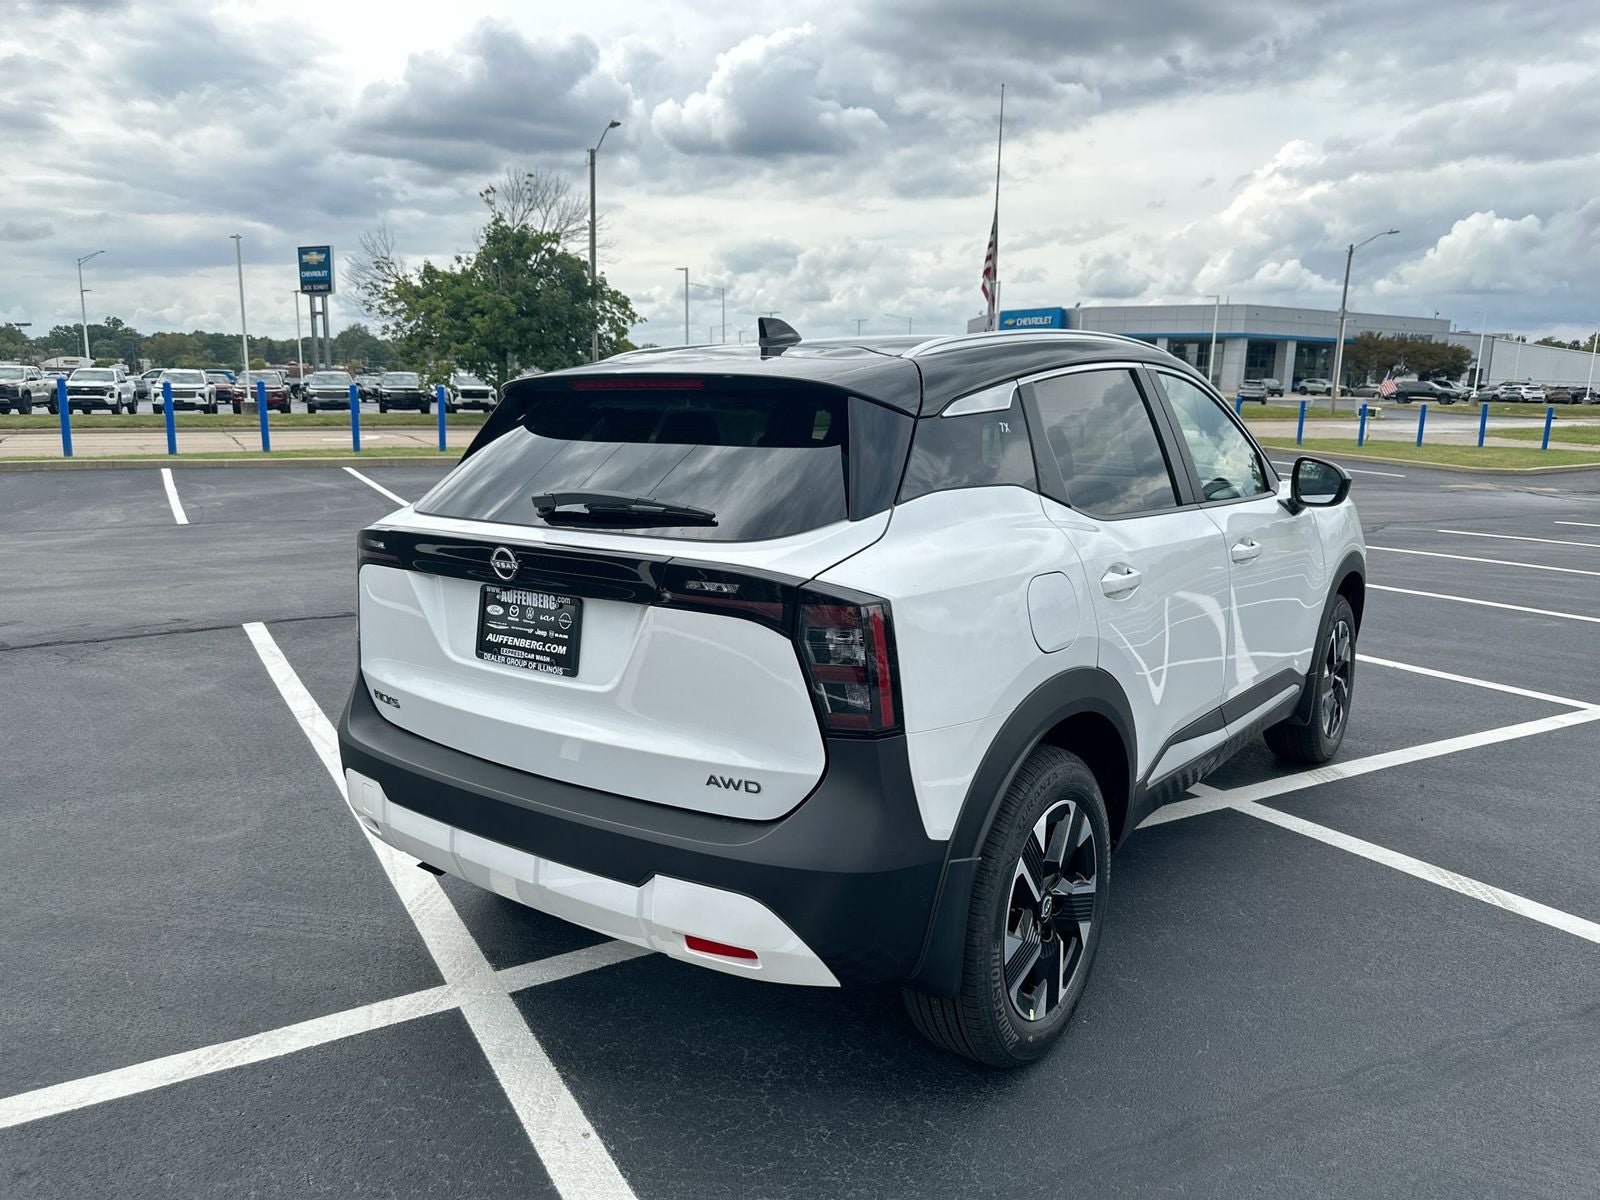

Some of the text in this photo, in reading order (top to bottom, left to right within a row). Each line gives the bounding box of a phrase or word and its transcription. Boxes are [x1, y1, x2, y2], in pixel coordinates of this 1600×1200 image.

[301, 270, 328, 278] CHEVROLET
[1016, 316, 1052, 326] CHEVROLET
[486, 633, 567, 655] AUFFENBERG.COM
[483, 652, 563, 675] DEALER GROUP OF ILLINOIS
[525, 652, 535, 660] CAR
[705, 774, 762, 794] AWD
